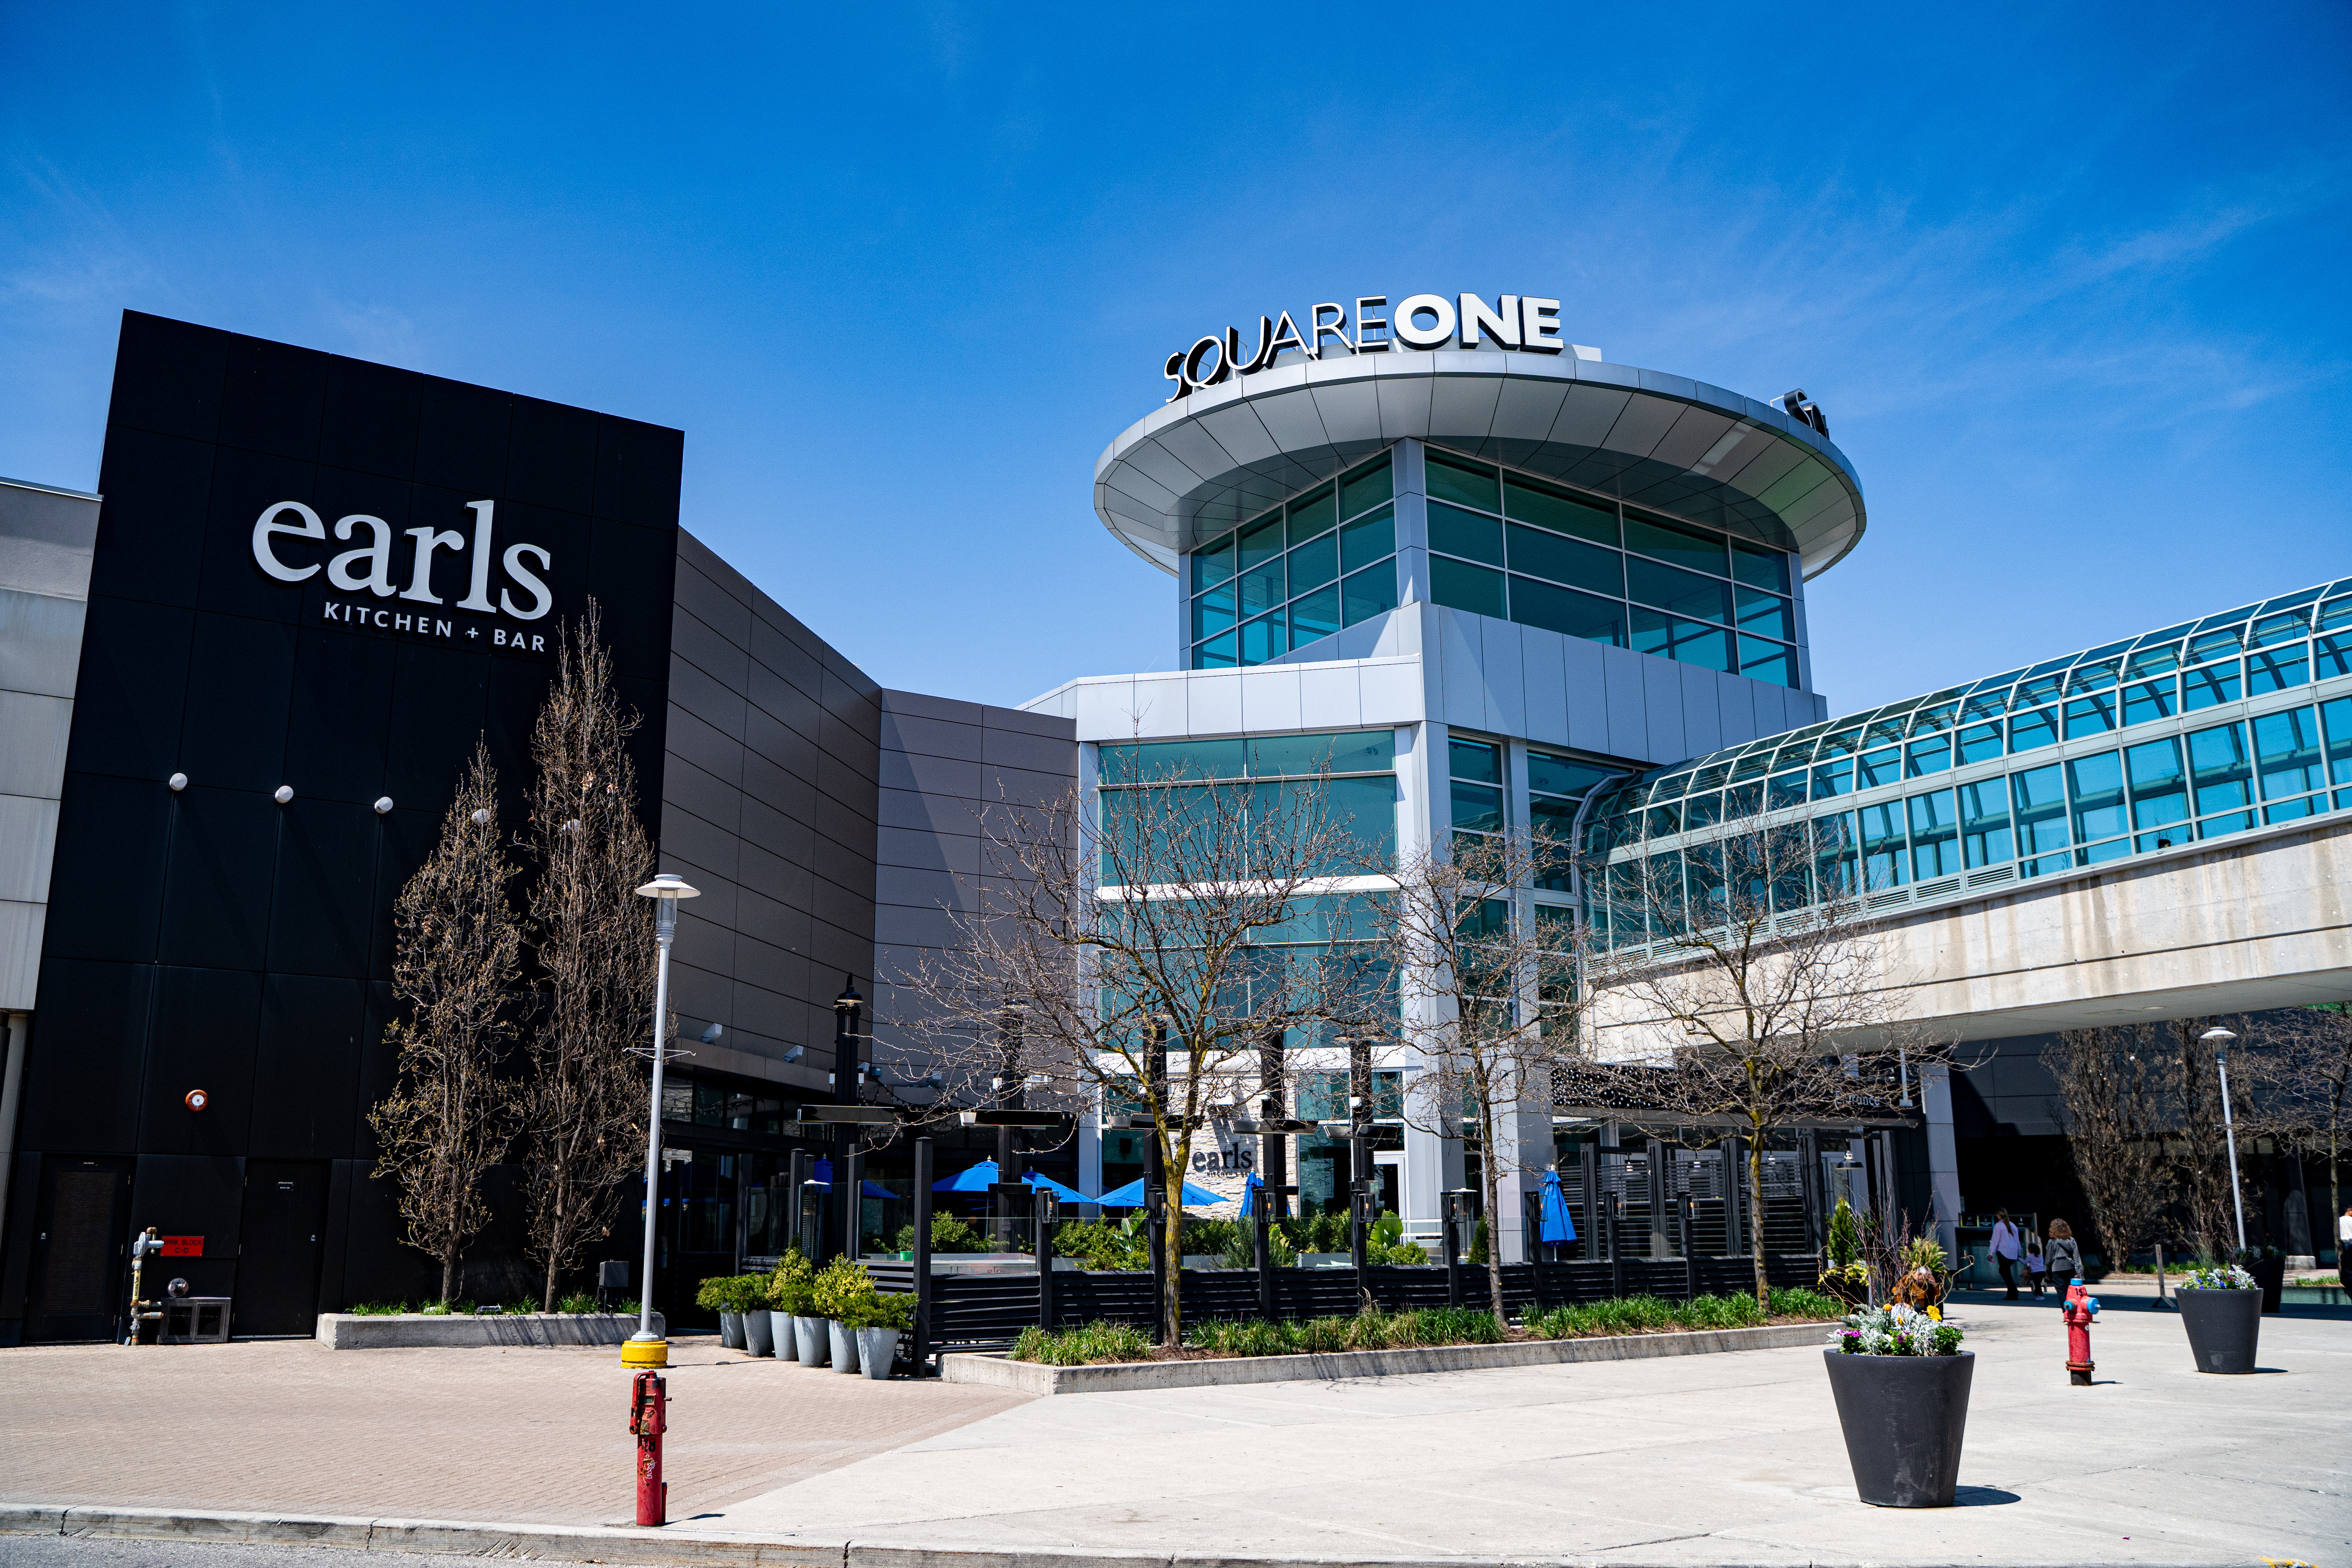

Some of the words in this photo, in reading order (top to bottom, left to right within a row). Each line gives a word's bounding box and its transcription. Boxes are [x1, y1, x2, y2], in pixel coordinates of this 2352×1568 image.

[252, 500, 552, 620] earls
[324, 602, 452, 637] KITCHEN
[494, 629, 545, 652] BAR
[1192, 1142, 1252, 1171] earls
